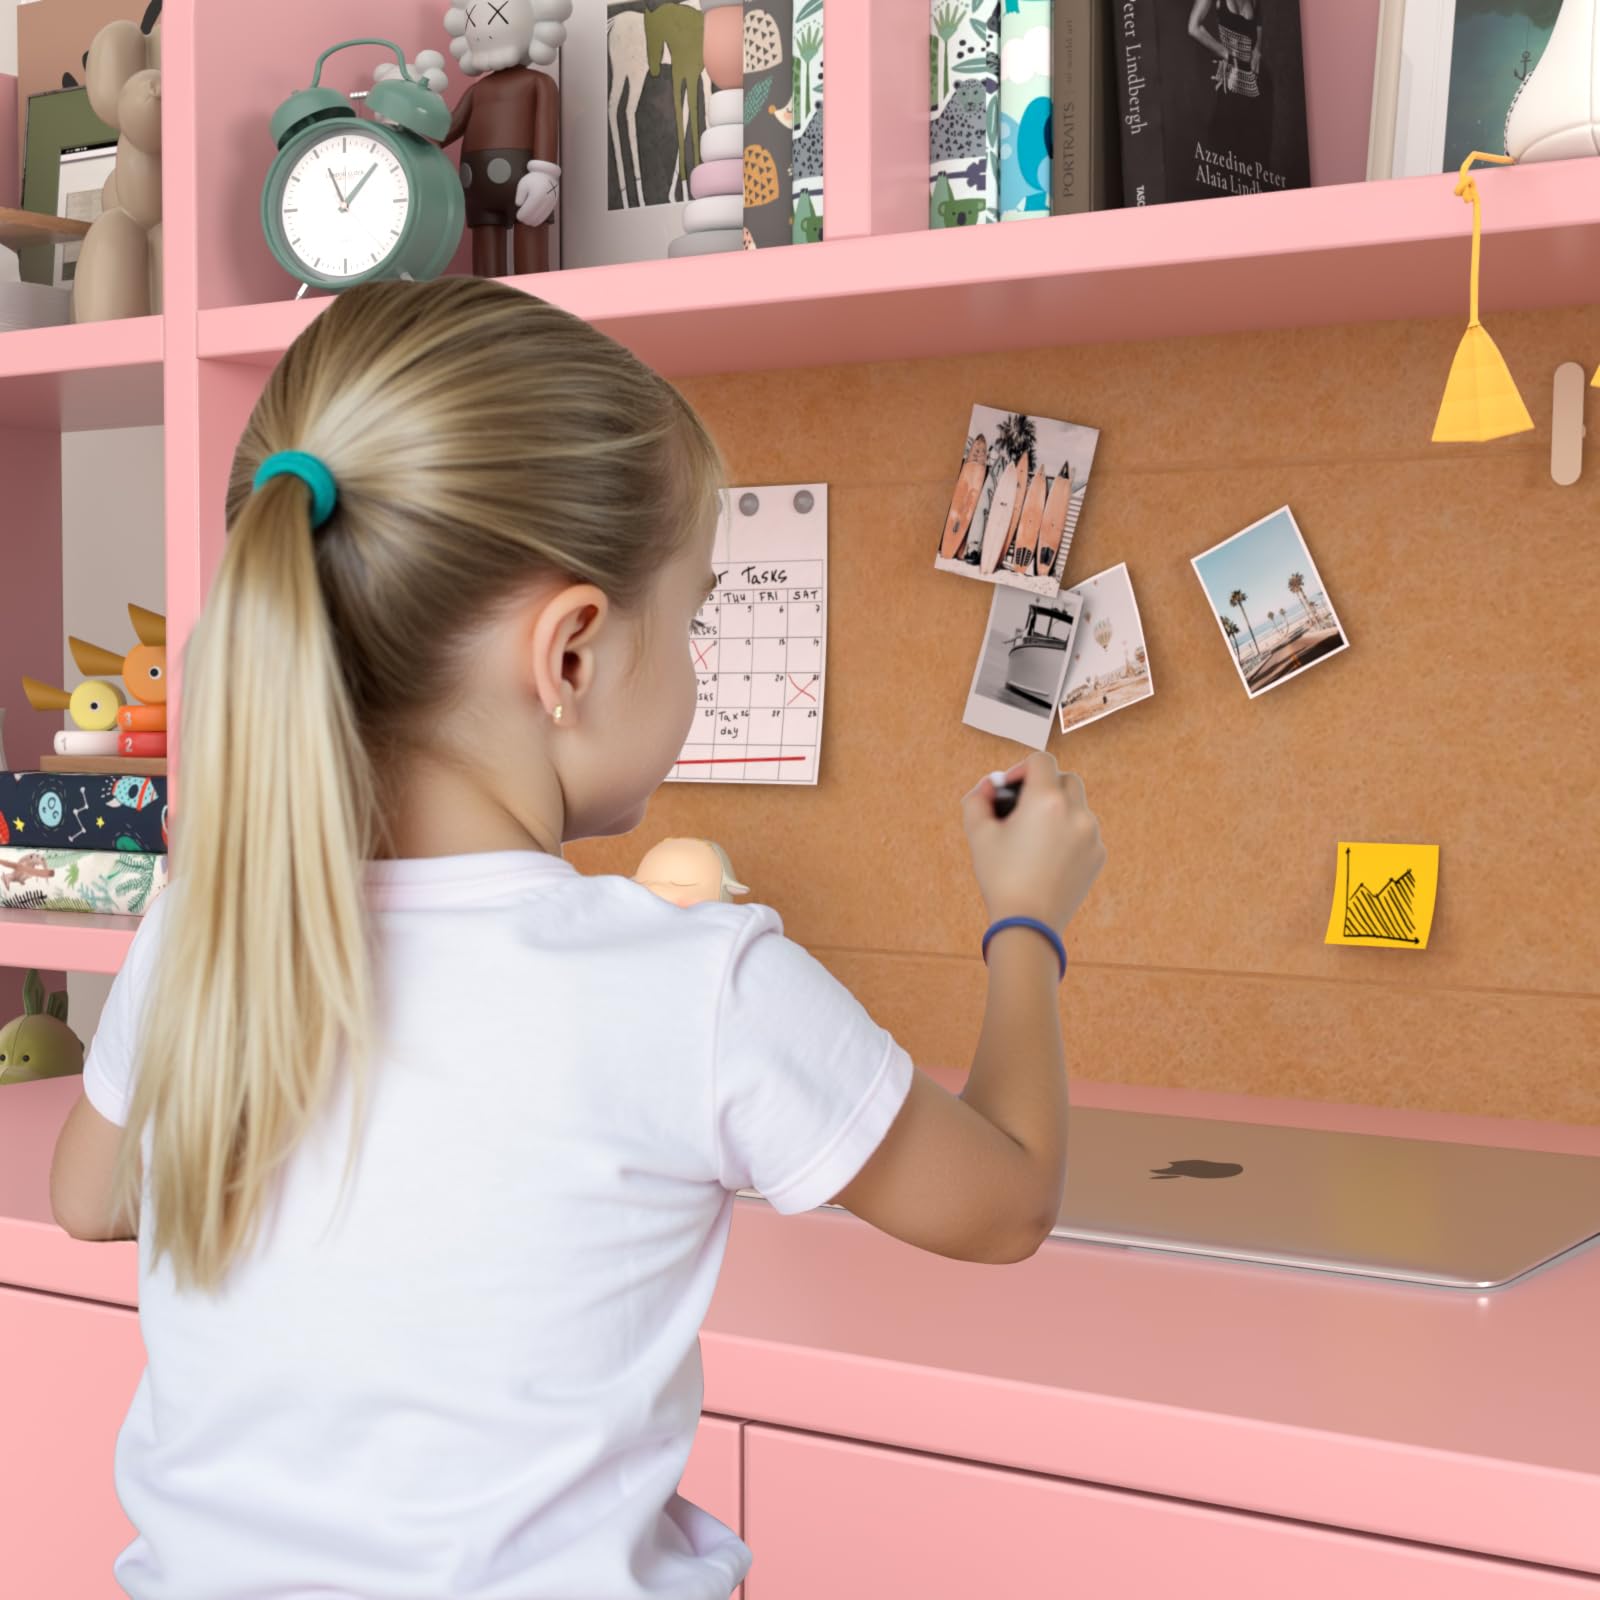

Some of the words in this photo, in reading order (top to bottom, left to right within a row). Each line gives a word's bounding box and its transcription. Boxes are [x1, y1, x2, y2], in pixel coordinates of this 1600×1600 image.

[1122, 0, 1136, 37] eter
[1124, 43, 1148, 135] Lindbergh
[1063, 102, 1075, 198] PORTRAITS
[1195, 141, 1253, 177] Azzedine
[1255, 161, 1287, 188] Peter
[1196, 164, 1228, 190] Alaïa
[1136, 184, 1146, 207] TASC
[724, 592, 746, 603] THU
[760, 591, 778, 601] FRI
[793, 590, 819, 600] SAT
[718, 710, 739, 722] Tax
[720, 726, 739, 739] day
[124, 737, 133, 753] 2
